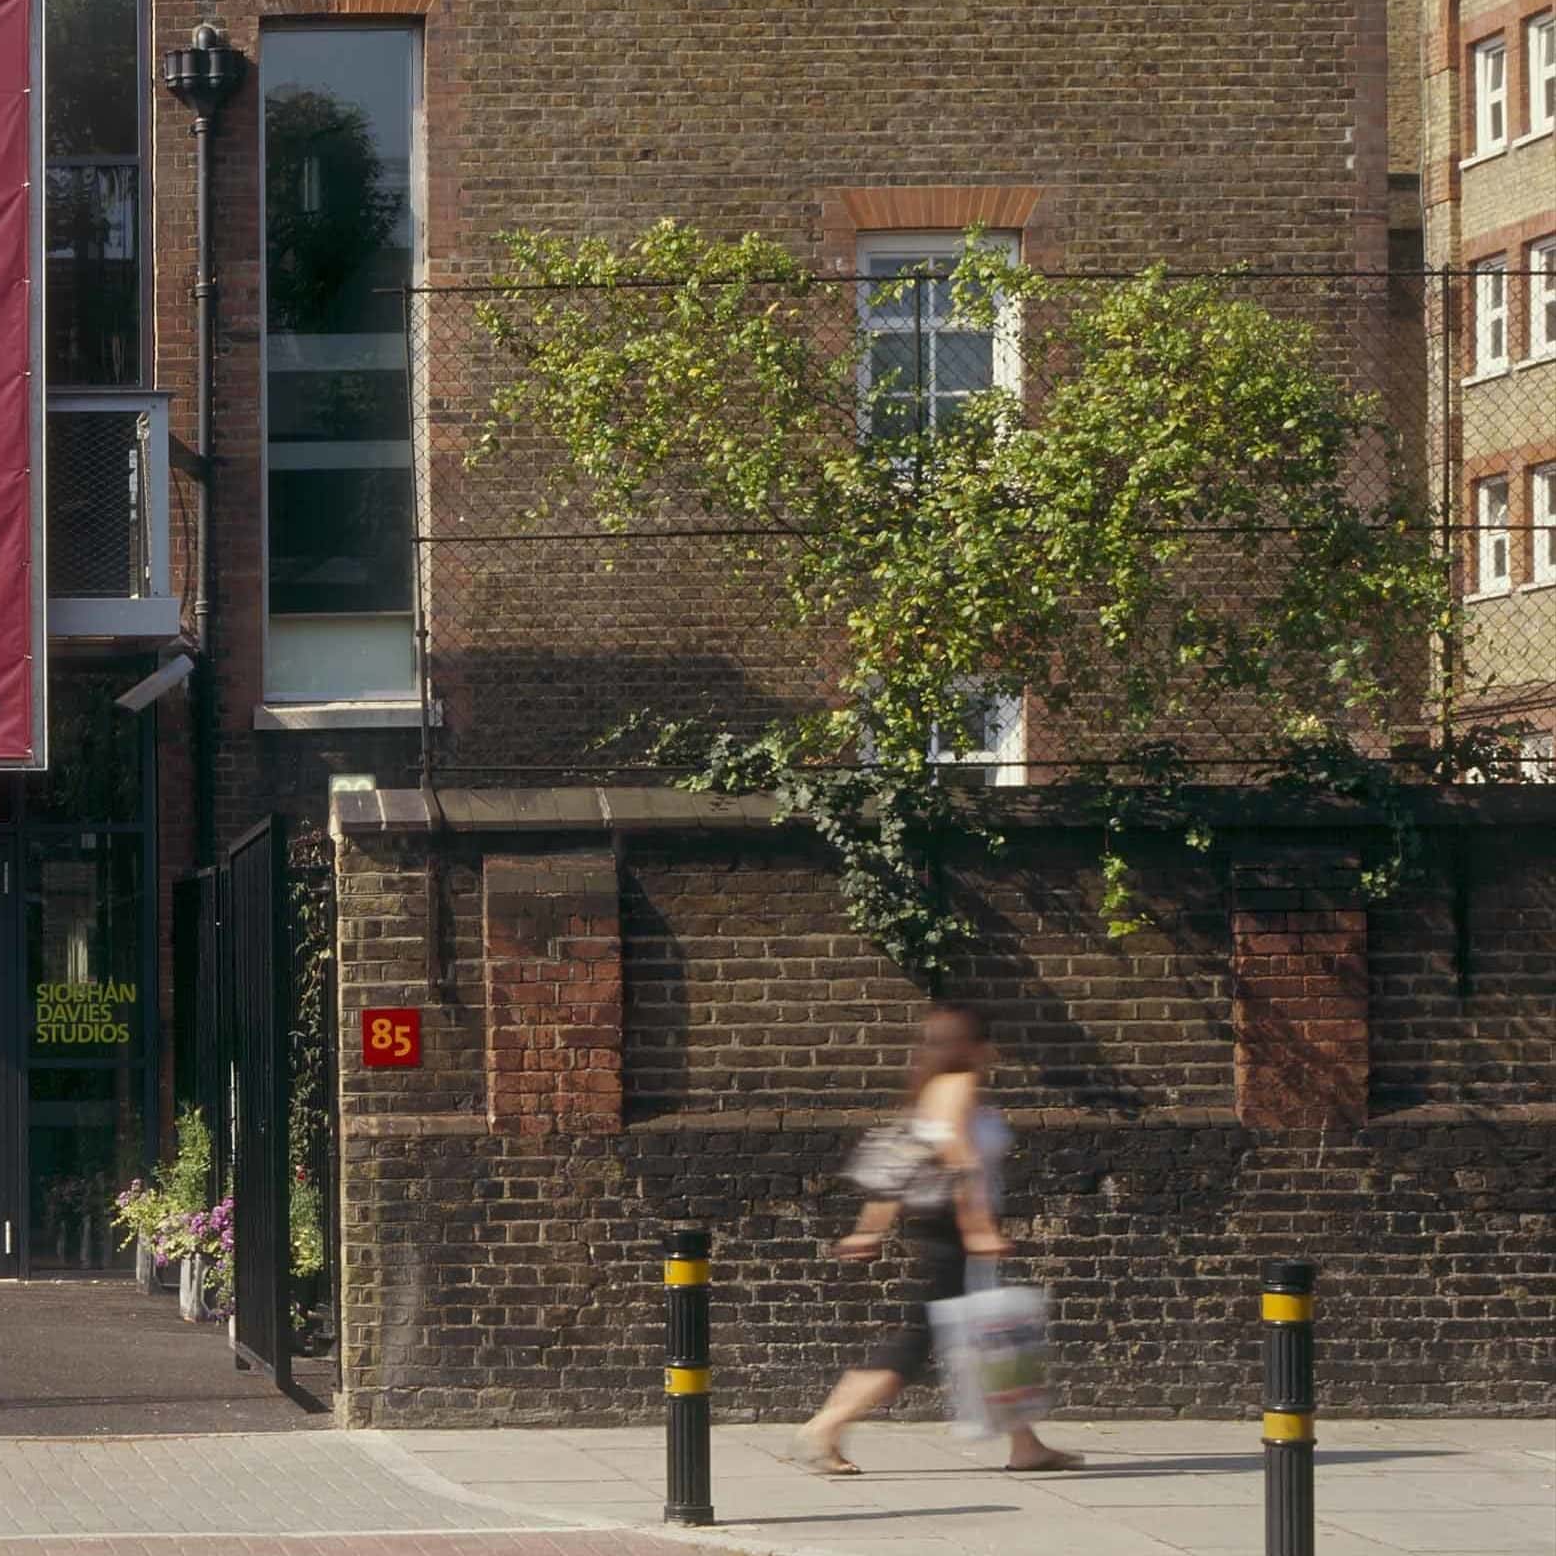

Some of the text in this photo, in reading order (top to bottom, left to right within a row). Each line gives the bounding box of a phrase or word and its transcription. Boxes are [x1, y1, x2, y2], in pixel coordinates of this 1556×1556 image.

[37, 982, 137, 1003] SIOBHAN
[37, 1004, 112, 1023] DAVIES
[37, 1023, 130, 1043] STUDIOS
[371, 1018, 412, 1057] 85
